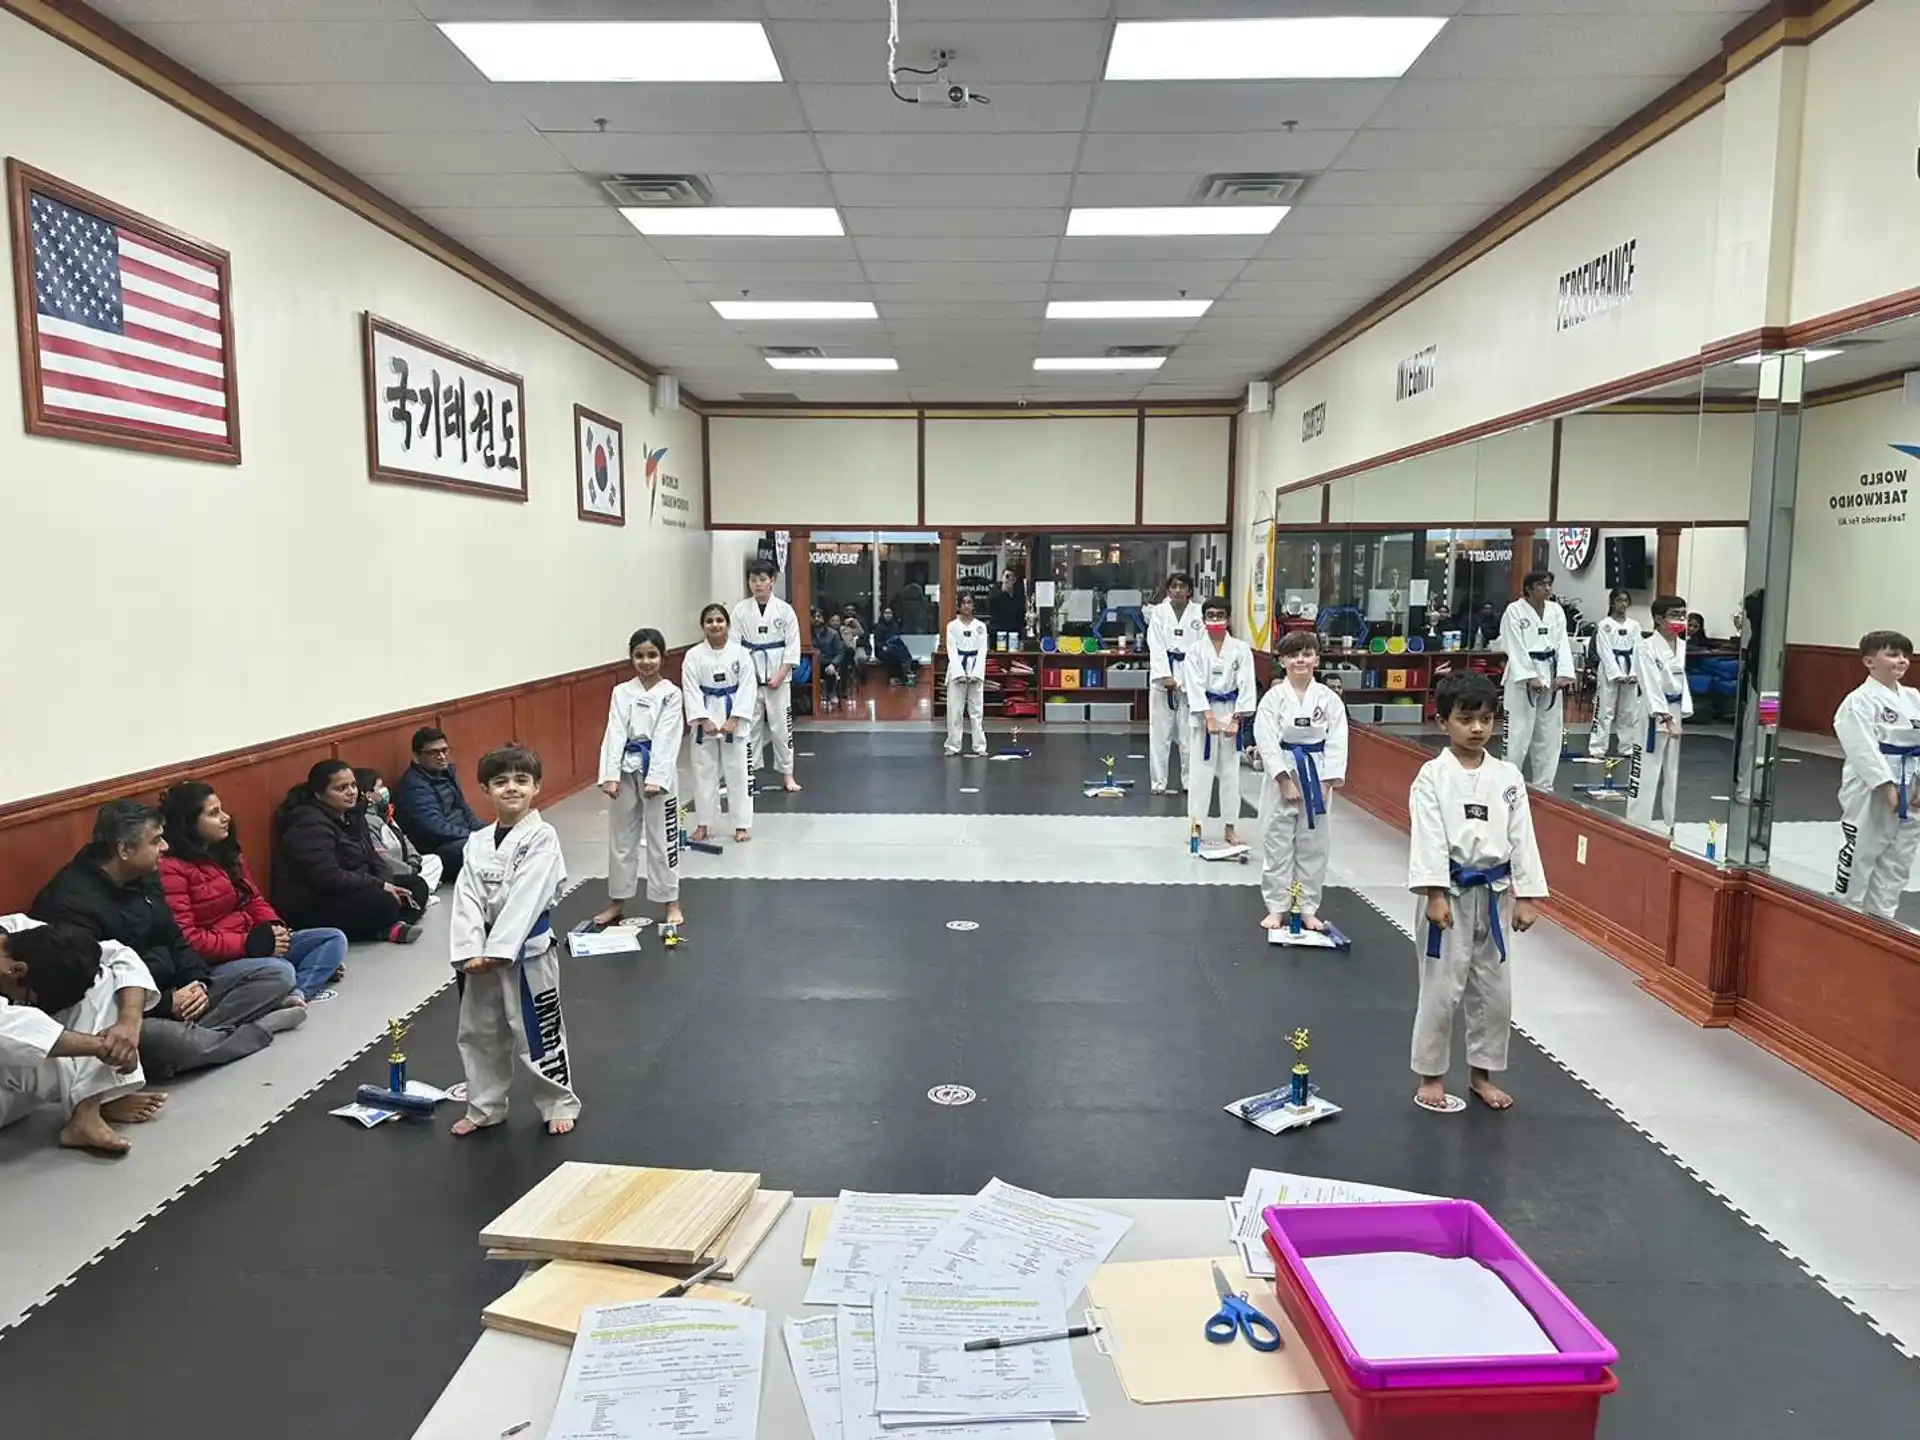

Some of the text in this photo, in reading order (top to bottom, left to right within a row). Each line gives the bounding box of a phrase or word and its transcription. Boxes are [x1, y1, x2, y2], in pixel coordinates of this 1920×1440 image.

[1557, 238, 1636, 332] PERSEVERANCE
[1396, 344, 1437, 402] INTEGRITY
[664, 796, 678, 868] UNITED TKD
[534, 987, 562, 1051] UNITED
